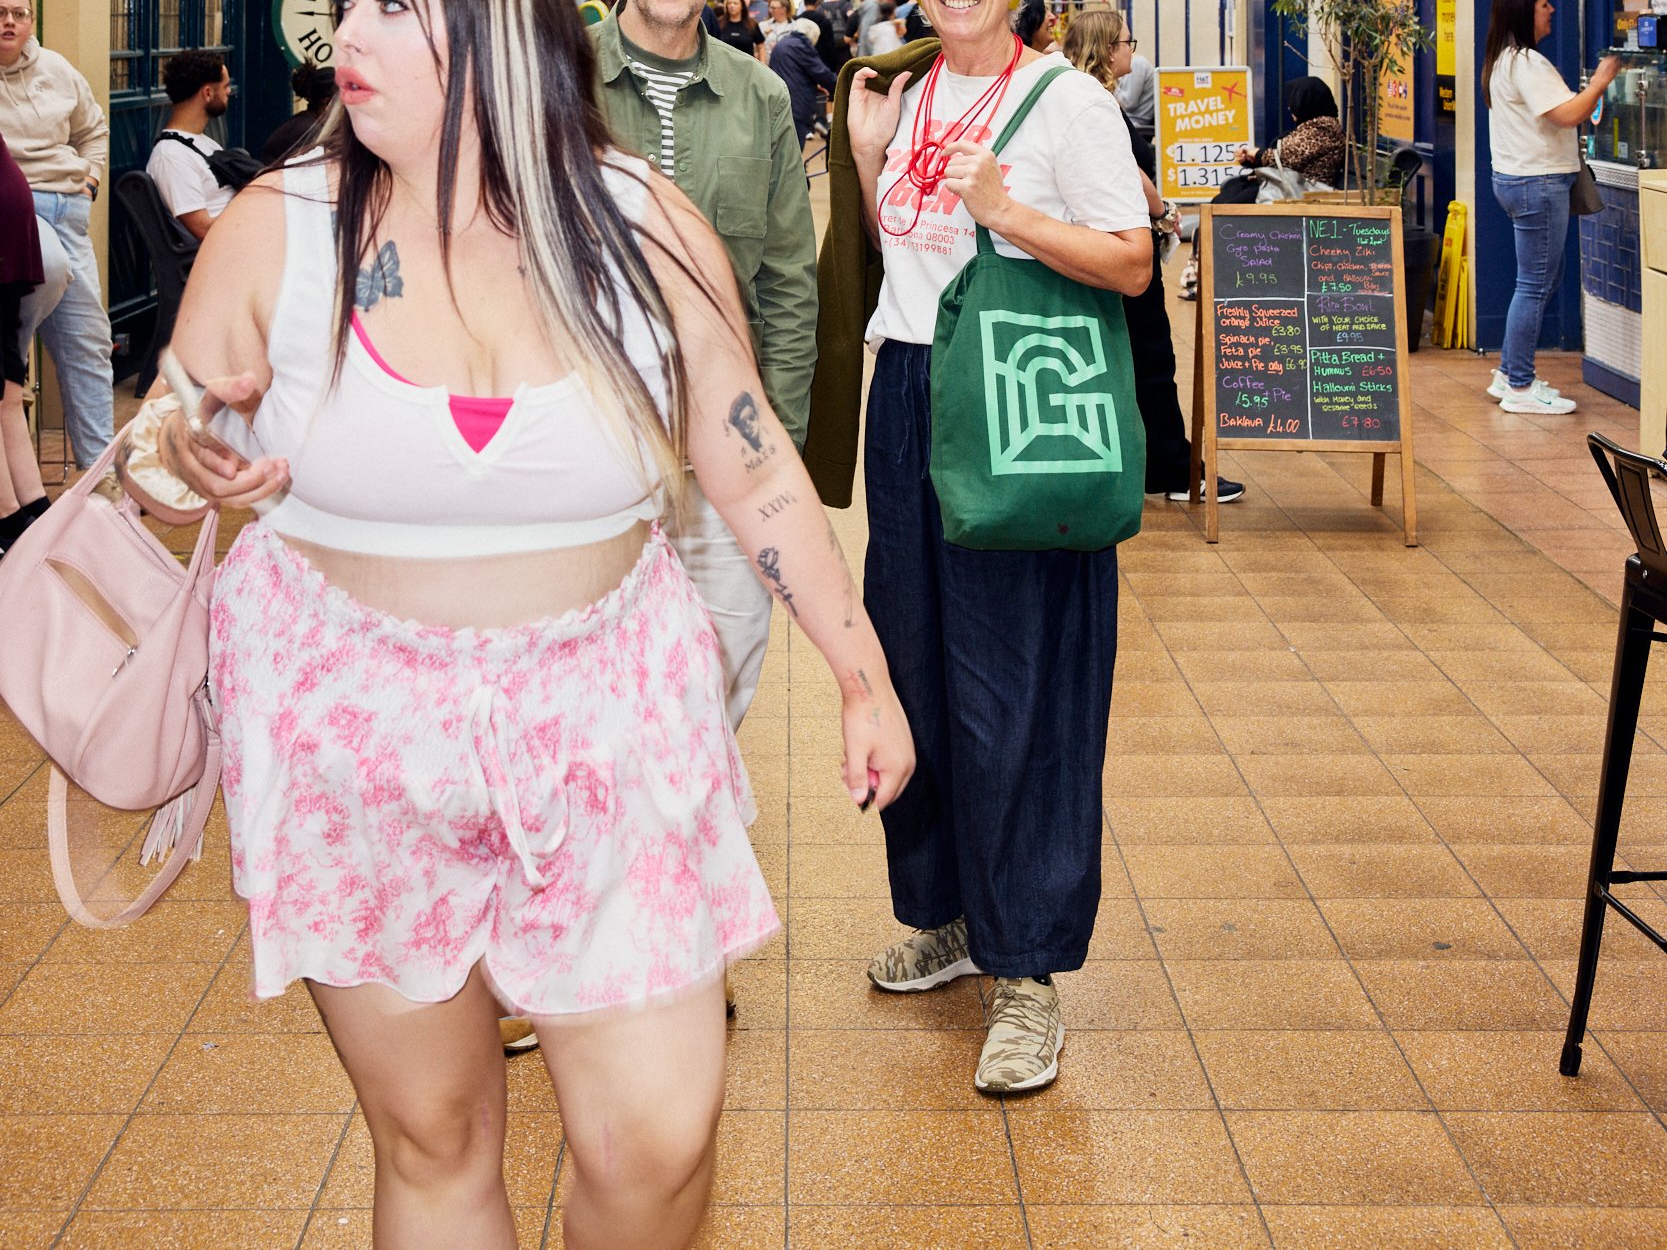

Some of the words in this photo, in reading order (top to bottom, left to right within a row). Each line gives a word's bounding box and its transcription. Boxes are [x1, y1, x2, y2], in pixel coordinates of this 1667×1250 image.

[1167, 96, 1225, 117] TRAVEL
[1175, 109, 1236, 132] MONEY
[1176, 143, 1248, 163] 1.125
[920, 220, 959, 235] Princesa
[963, 228, 975, 238] 14
[1219, 223, 1267, 246] Creamy
[1269, 231, 1302, 239] Chicken
[1348, 221, 1390, 241] Tuesdays
[926, 232, 955, 245] 08003
[1309, 245, 1351, 264] Cheeky
[1321, 281, 1352, 293] £7.50
[1216, 303, 1250, 319] Freshly
[1251, 304, 1298, 318] Squeezed
[1316, 296, 1339, 313] Rice
[1220, 317, 1250, 328] orange
[1254, 317, 1280, 327] Juice
[1219, 333, 1255, 345] Spinach
[1220, 345, 1244, 356] Feta
[1248, 347, 1262, 358] pie
[1311, 349, 1339, 364] Pitta
[1342, 351, 1374, 364] Bread
[1219, 358, 1243, 369] Juice
[1252, 358, 1265, 371] Pie
[1222, 375, 1265, 389] Coffee
[1313, 380, 1356, 393] Halloumi
[1359, 381, 1392, 392] Sticks
[1272, 387, 1292, 403] Pie
